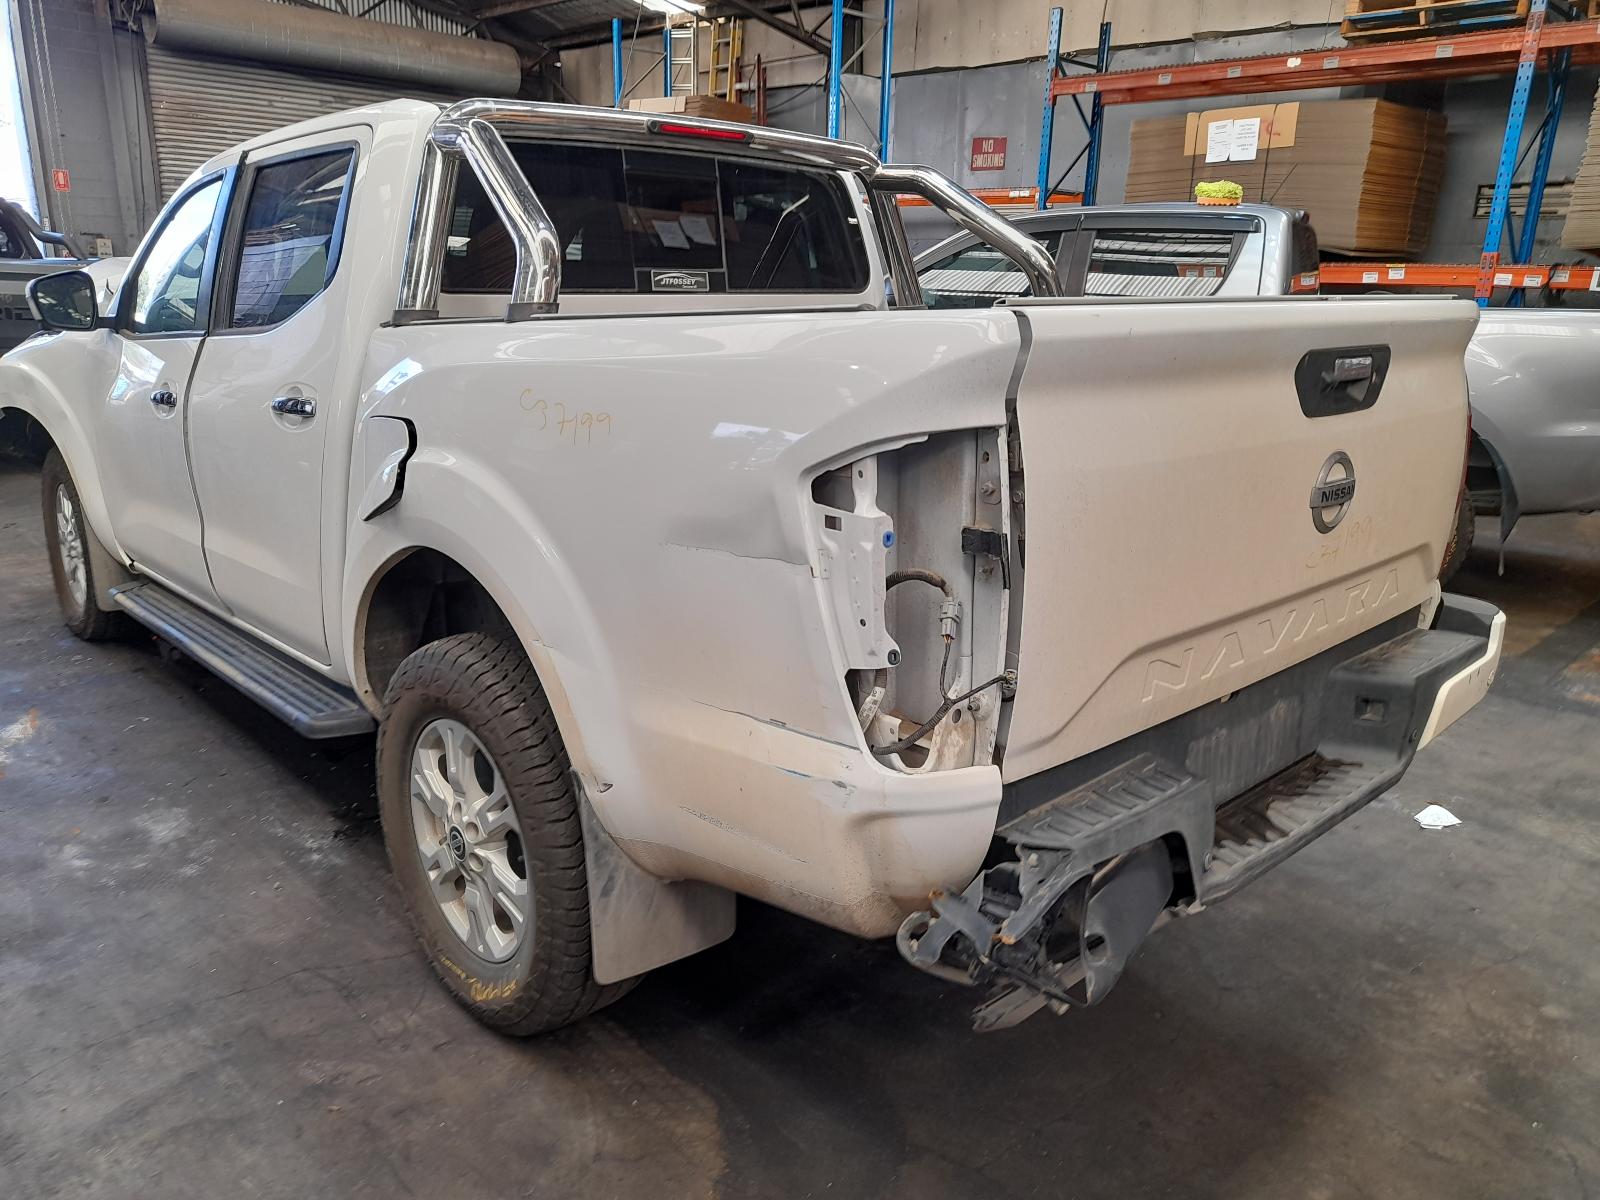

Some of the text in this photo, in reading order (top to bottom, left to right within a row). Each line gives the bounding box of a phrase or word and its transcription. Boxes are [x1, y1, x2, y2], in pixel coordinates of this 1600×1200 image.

[982, 139, 994, 153] NO
[972, 153, 1005, 168] SMOKING
[1142, 567, 1400, 703] NAVARA
